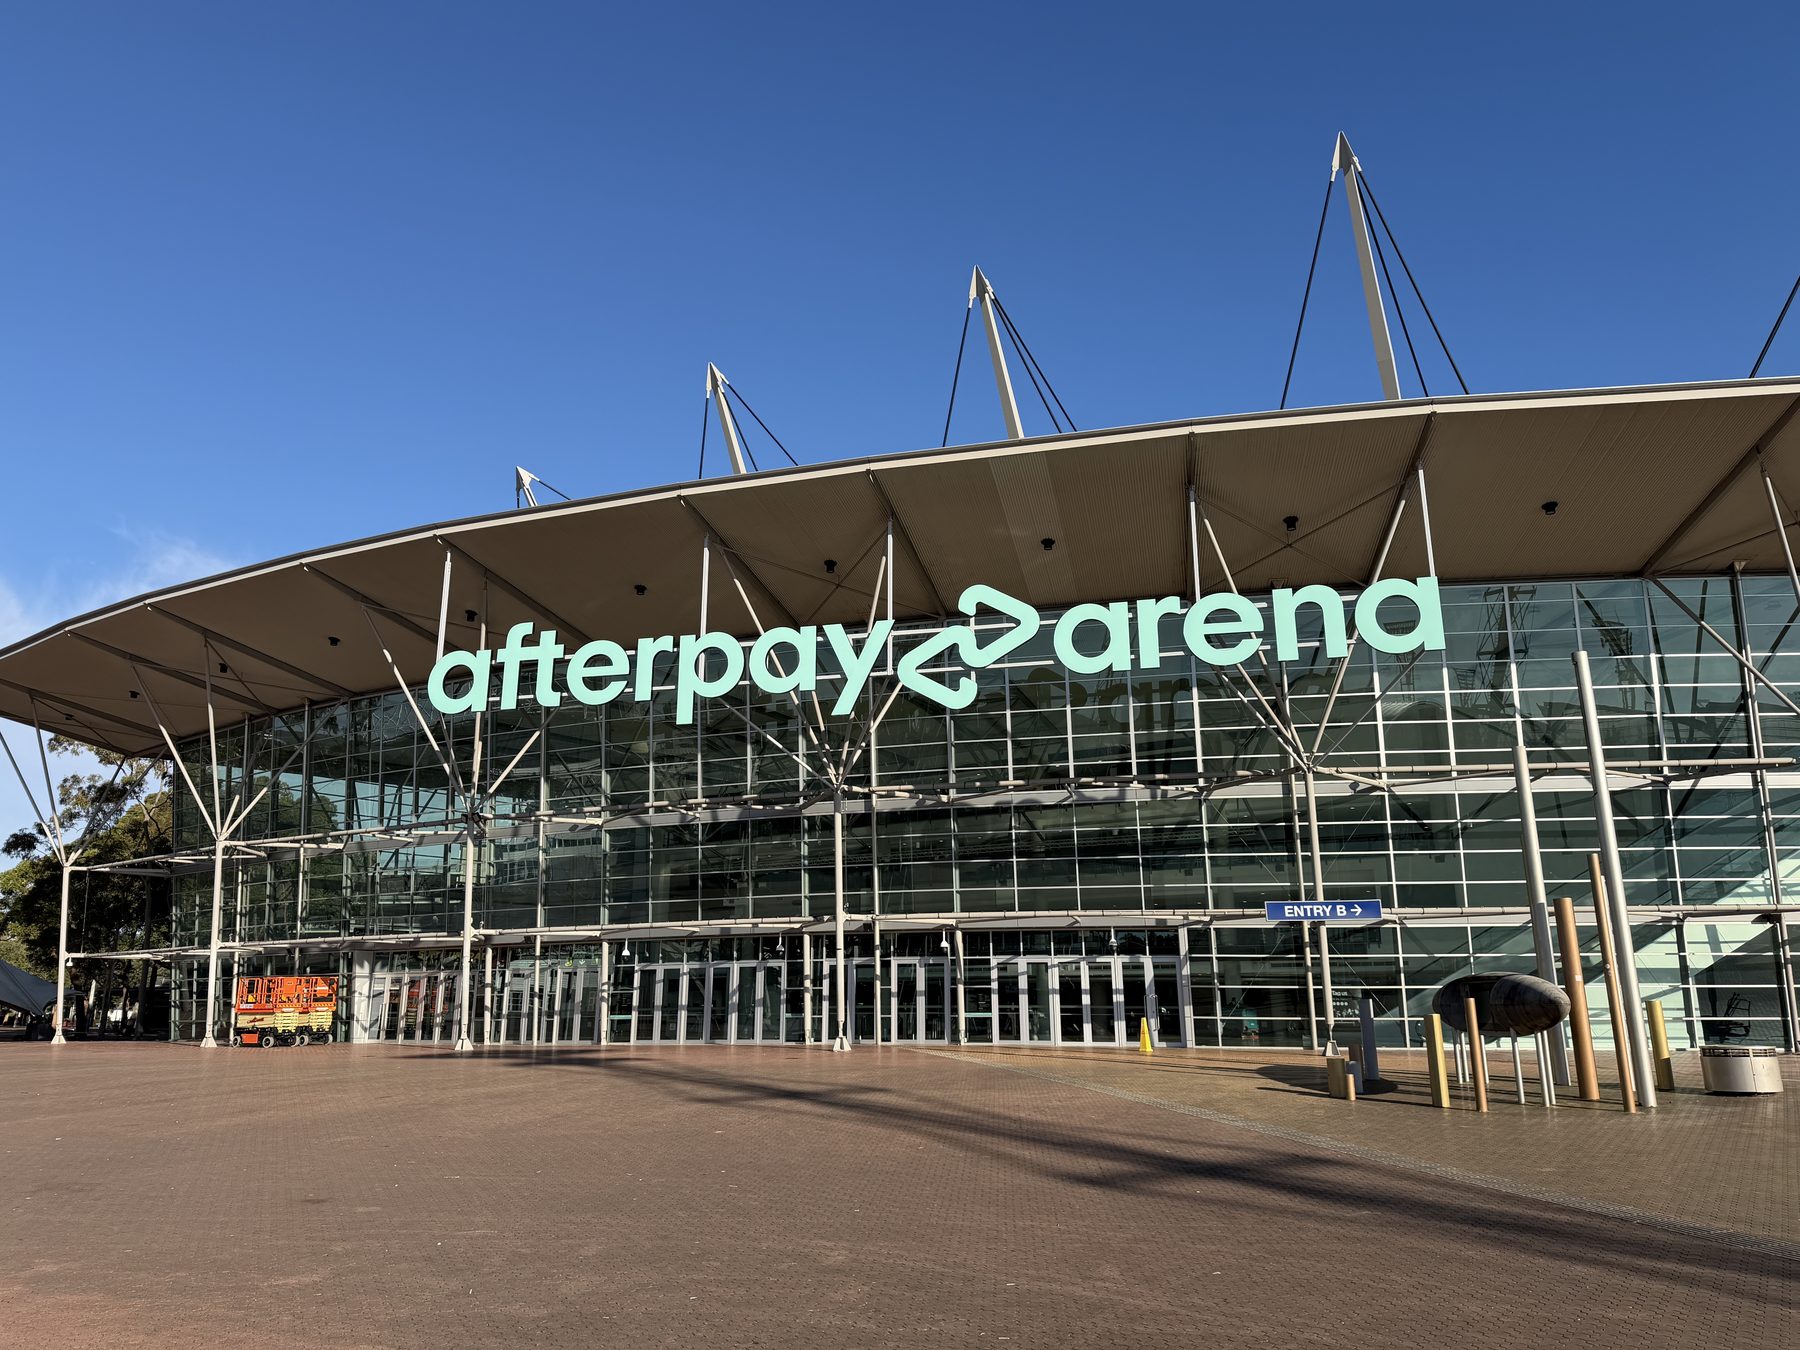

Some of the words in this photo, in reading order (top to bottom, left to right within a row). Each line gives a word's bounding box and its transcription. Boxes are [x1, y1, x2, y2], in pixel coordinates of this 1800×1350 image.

[428, 620, 894, 725] afterpay
[1053, 577, 1445, 675] arena
[1284, 905, 1332, 917] ENTRY
[1336, 905, 1347, 916] B
